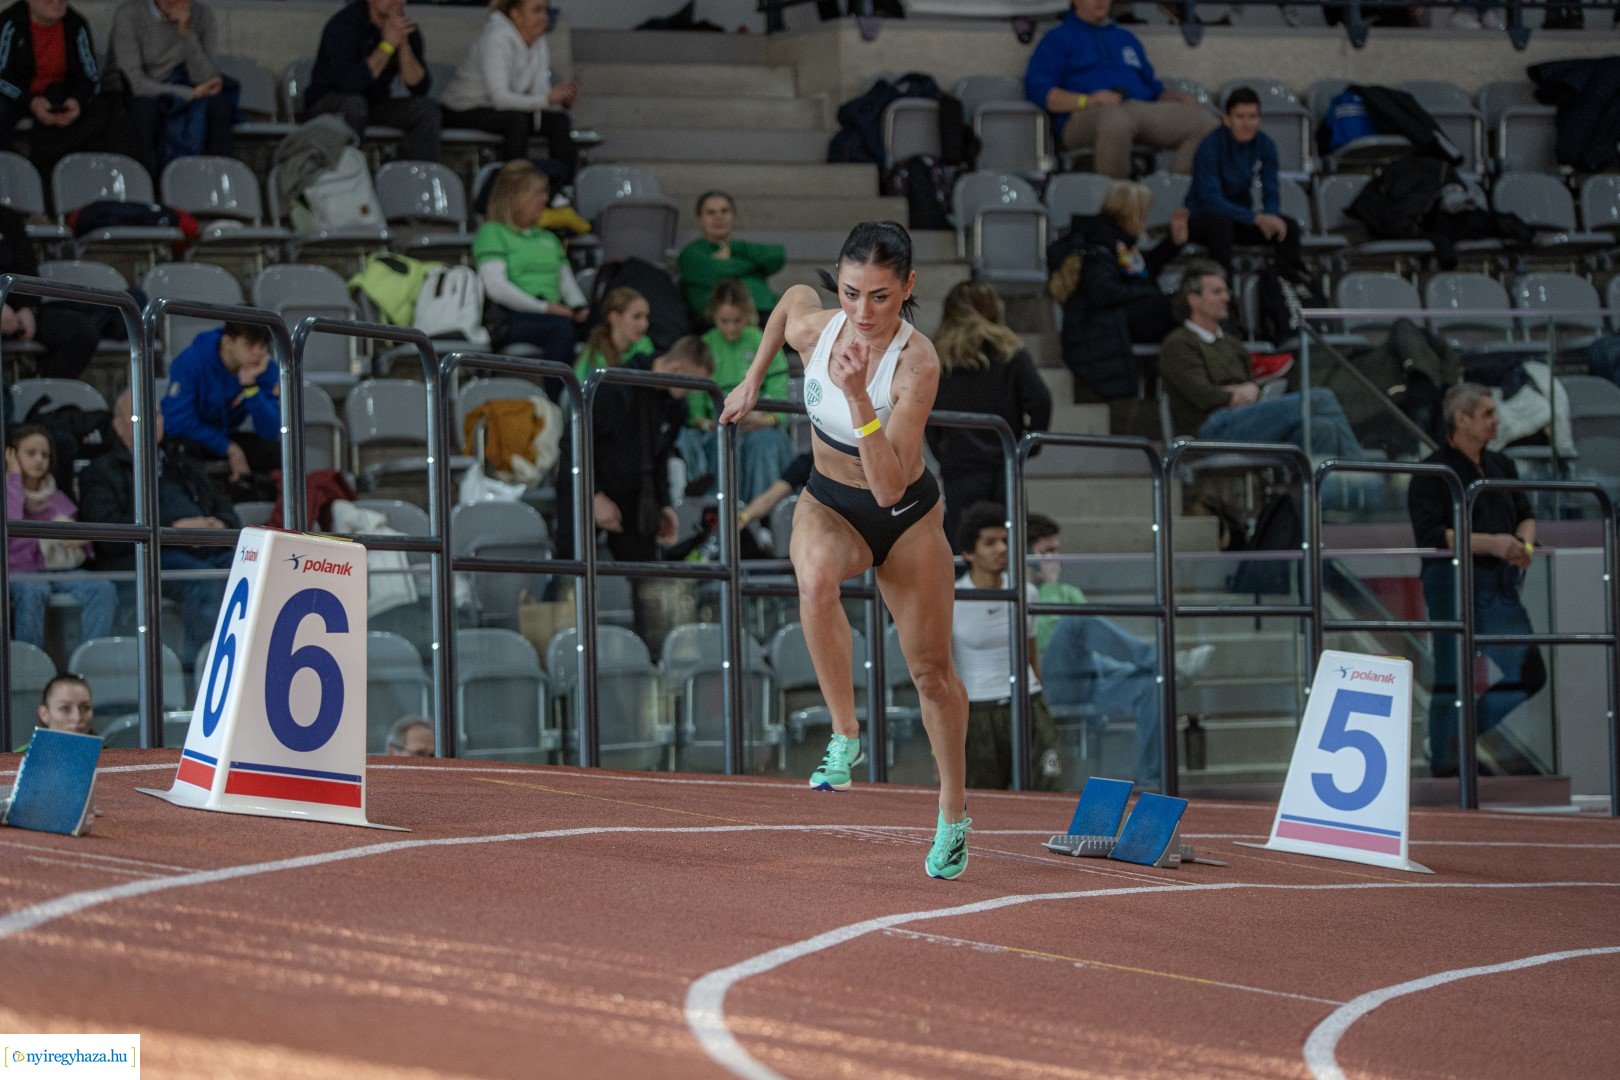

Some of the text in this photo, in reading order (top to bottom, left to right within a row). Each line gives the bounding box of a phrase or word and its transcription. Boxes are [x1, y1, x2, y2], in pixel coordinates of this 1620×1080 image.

[303, 559, 353, 576] polanik
[202, 576, 249, 738] 6
[264, 587, 349, 752] 6
[1349, 670, 1396, 684] polanik
[1311, 688, 1393, 811] 5
